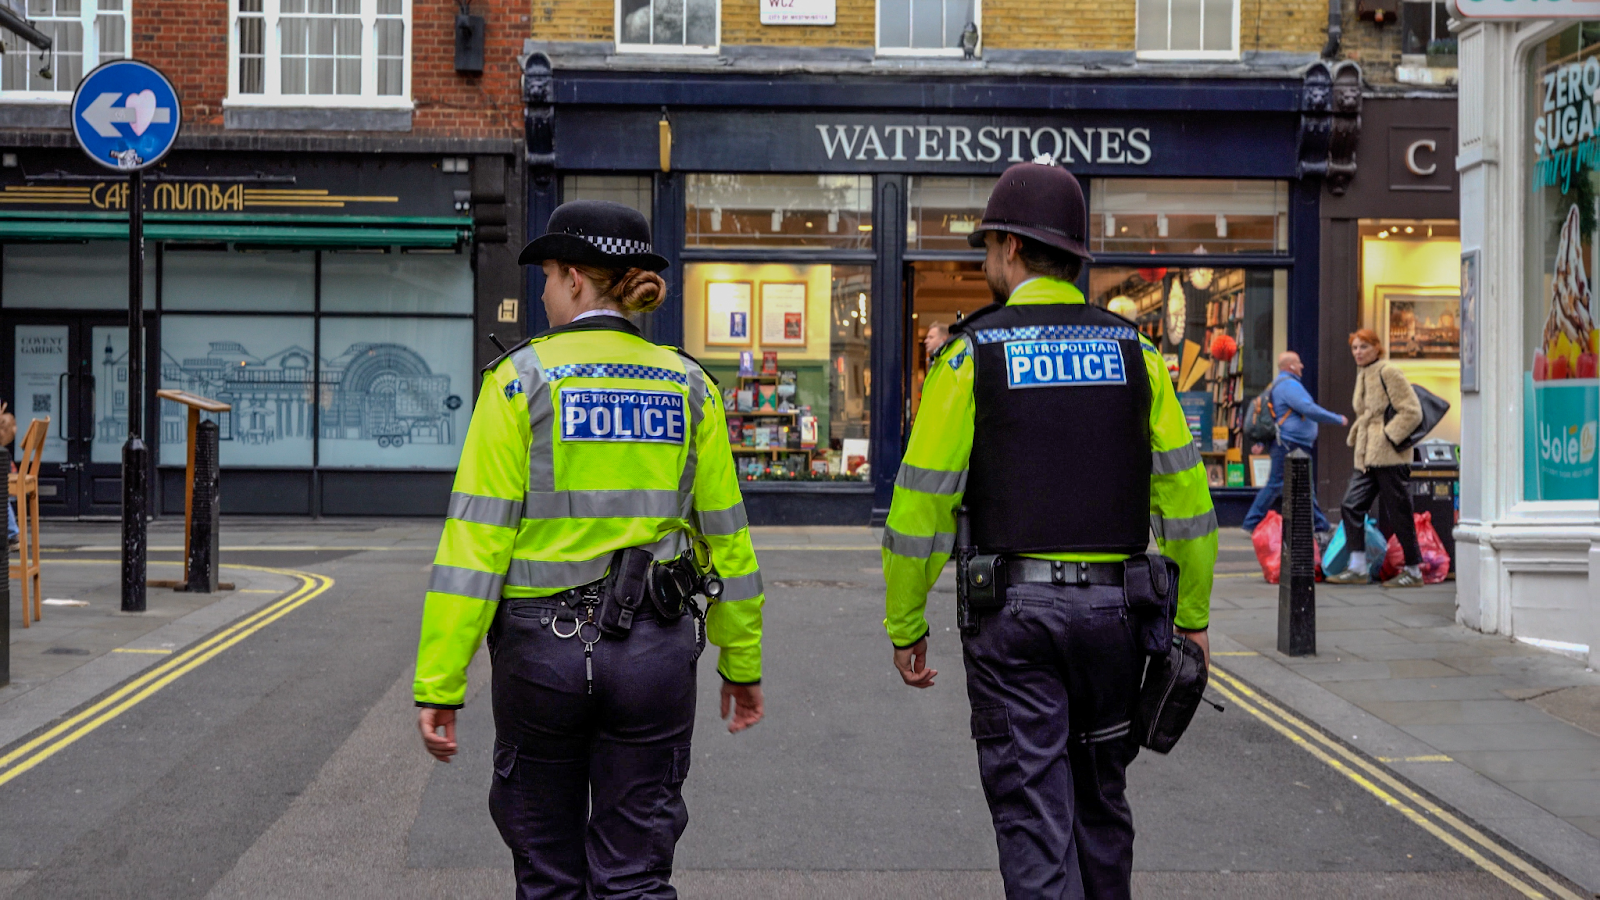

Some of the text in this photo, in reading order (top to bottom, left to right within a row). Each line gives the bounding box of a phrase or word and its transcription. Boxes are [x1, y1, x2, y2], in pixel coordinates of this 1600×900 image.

[769, 0, 795, 8] WC2
[1543, 55, 1600, 113] ZERO
[815, 124, 1153, 165] WATERSTONES
[1406, 139, 1437, 175] C
[91, 182, 244, 211] CAF MUMBAI
[21, 346, 63, 354] GARDEN
[1010, 342, 1117, 356] METROPOLITAN
[1012, 353, 1121, 384] POLICE
[565, 392, 682, 408] METROPOLITAN
[565, 406, 683, 439] POLICE
